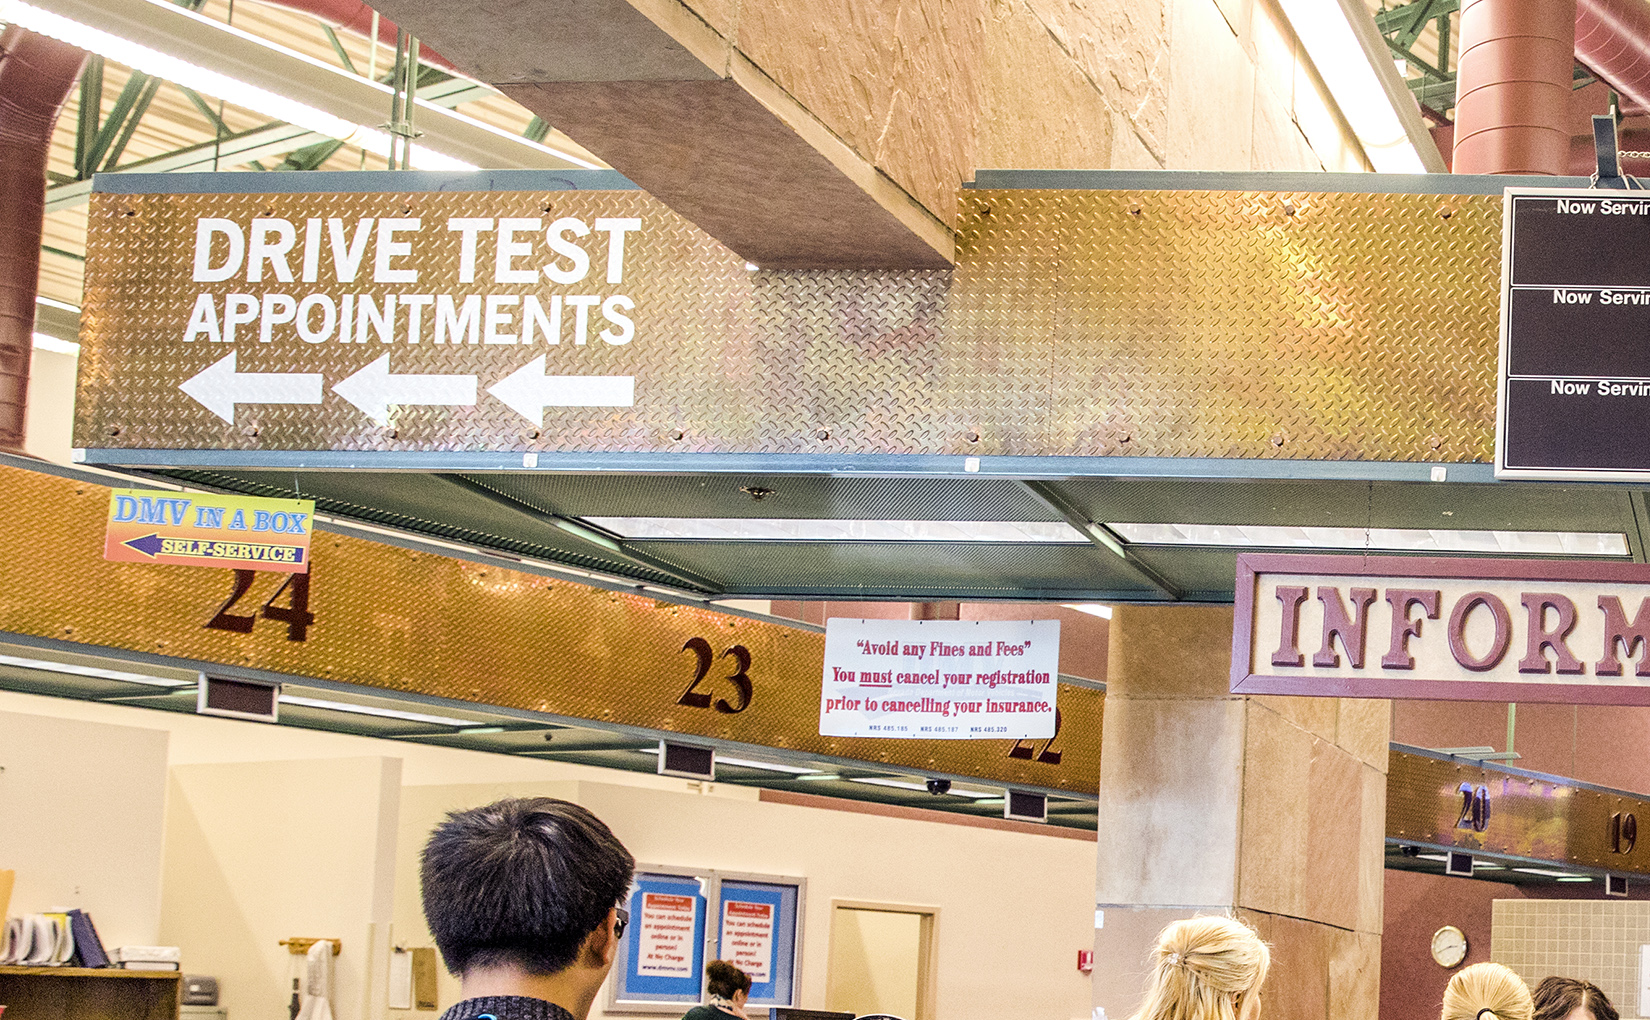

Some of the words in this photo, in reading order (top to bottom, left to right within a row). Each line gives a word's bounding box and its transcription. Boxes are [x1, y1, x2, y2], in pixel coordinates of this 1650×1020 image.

[1557, 200, 1595, 214] Now
[193, 218, 421, 283] DRIVE
[447, 218, 641, 284] TEST
[1553, 289, 1592, 304] Now
[182, 293, 635, 346] APPOINTMENTS
[1551, 380, 1590, 395] Now
[113, 495, 191, 526] DMV
[194, 506, 225, 529] IN
[228, 509, 248, 530] A
[252, 511, 308, 534] BOX
[161, 539, 296, 561] SELF-SERVICE
[203, 562, 314, 641] 24
[903, 644, 927, 660] any
[929, 641, 965, 657] Fines
[968, 641, 992, 657] and
[675, 637, 753, 714] 23
[832, 667, 855, 682] You
[859, 669, 892, 685] must
[896, 669, 939, 685] cancel
[943, 673, 972, 688] your
[976, 669, 1050, 688] registration
[826, 696, 860, 714] prior
[865, 697, 877, 711] to
[881, 697, 950, 717] cancelling
[953, 701, 983, 716] your
[986, 698, 1052, 713] insurance.
[1453, 782, 1491, 832] 20
[1612, 812, 1637, 855] 19
